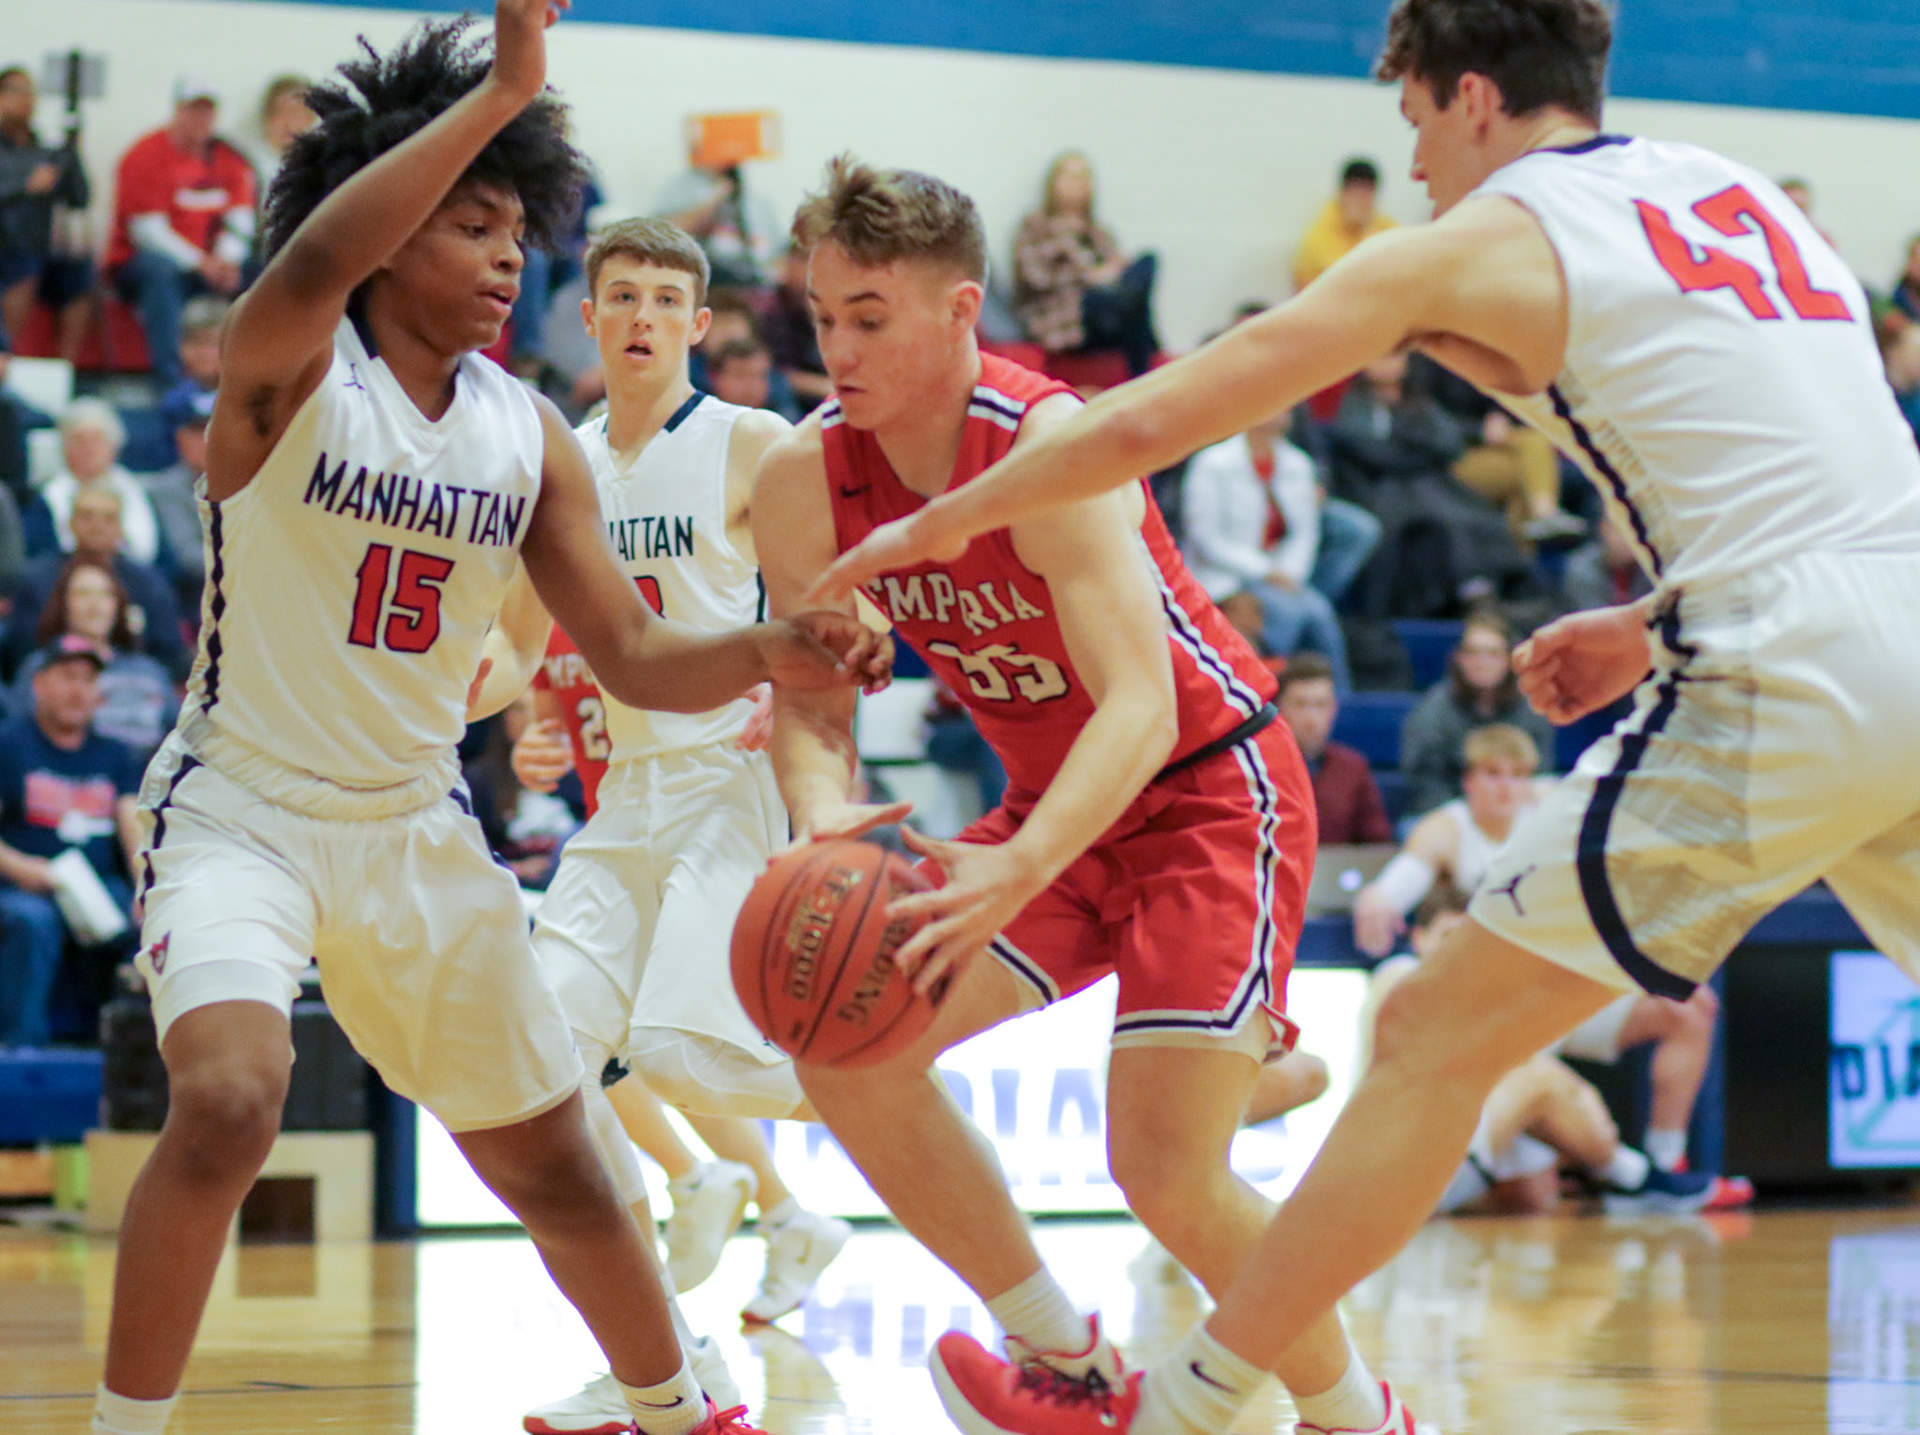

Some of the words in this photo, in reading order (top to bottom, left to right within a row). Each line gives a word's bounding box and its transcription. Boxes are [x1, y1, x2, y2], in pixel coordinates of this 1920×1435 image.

[1630, 183, 1857, 322] 42
[303, 451, 526, 547] MANHATTAN
[347, 542, 456, 654] 15
